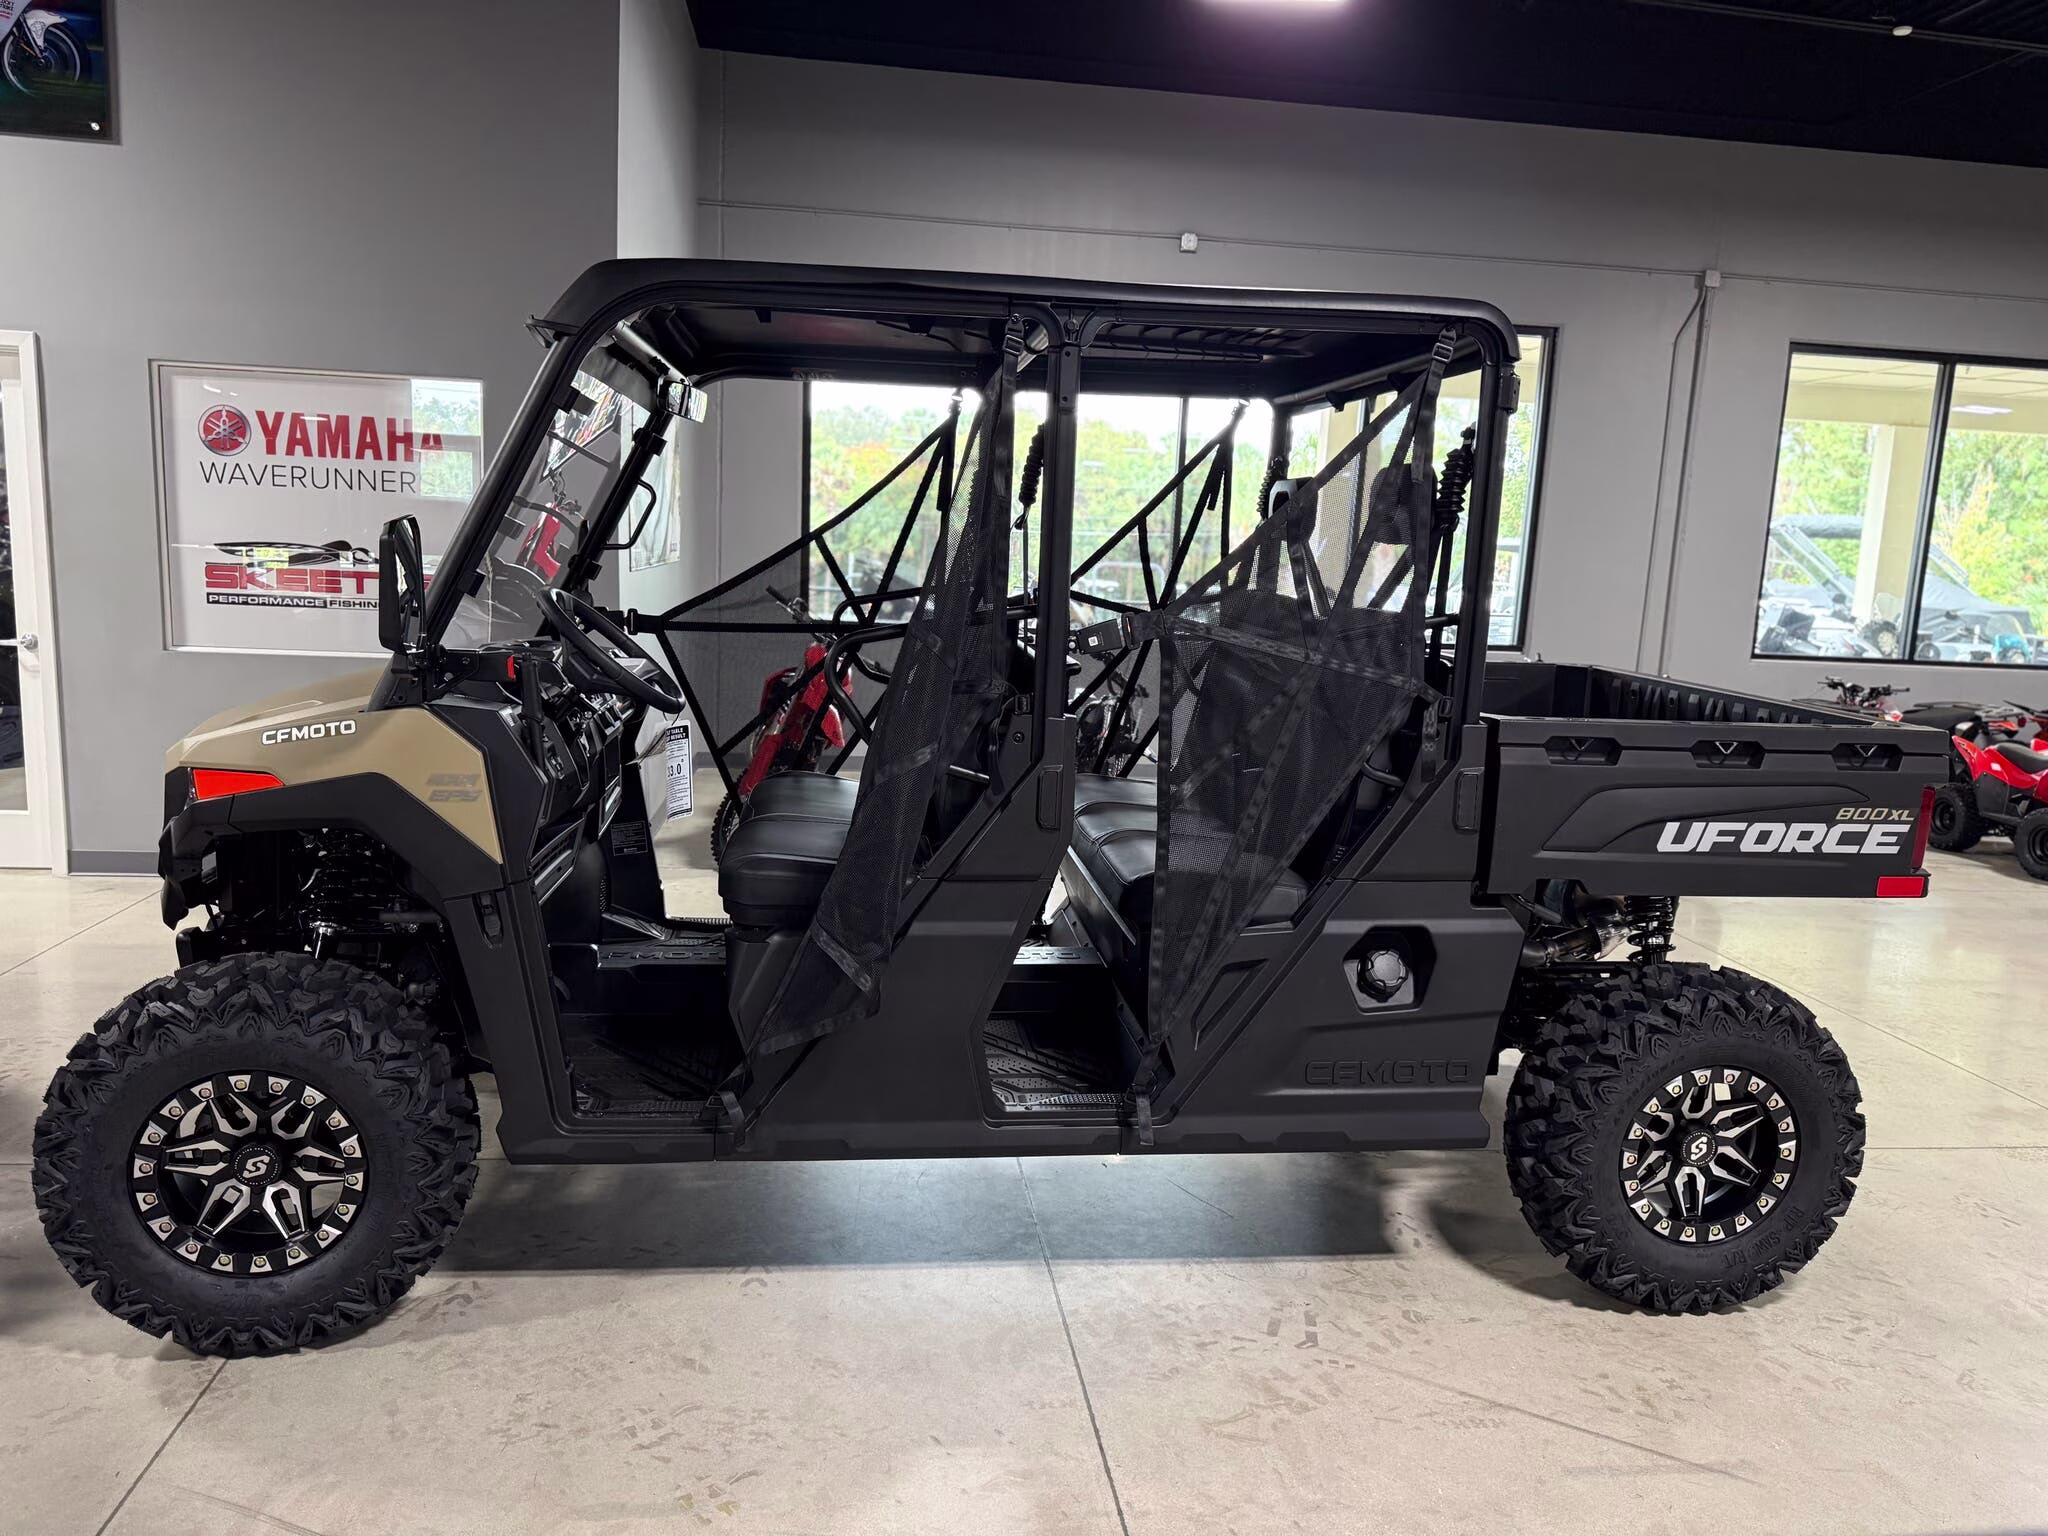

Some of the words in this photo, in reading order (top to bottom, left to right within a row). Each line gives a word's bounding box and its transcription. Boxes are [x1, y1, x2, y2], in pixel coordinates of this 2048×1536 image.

[205, 564, 379, 594] SKEET
[209, 594, 325, 607] PERFORMANCE
[329, 599, 378, 609] FISHIN
[261, 719, 357, 745] CFMOTO
[1656, 822, 1912, 854] UFORCE
[1305, 1060, 1470, 1085] CFMOTO
